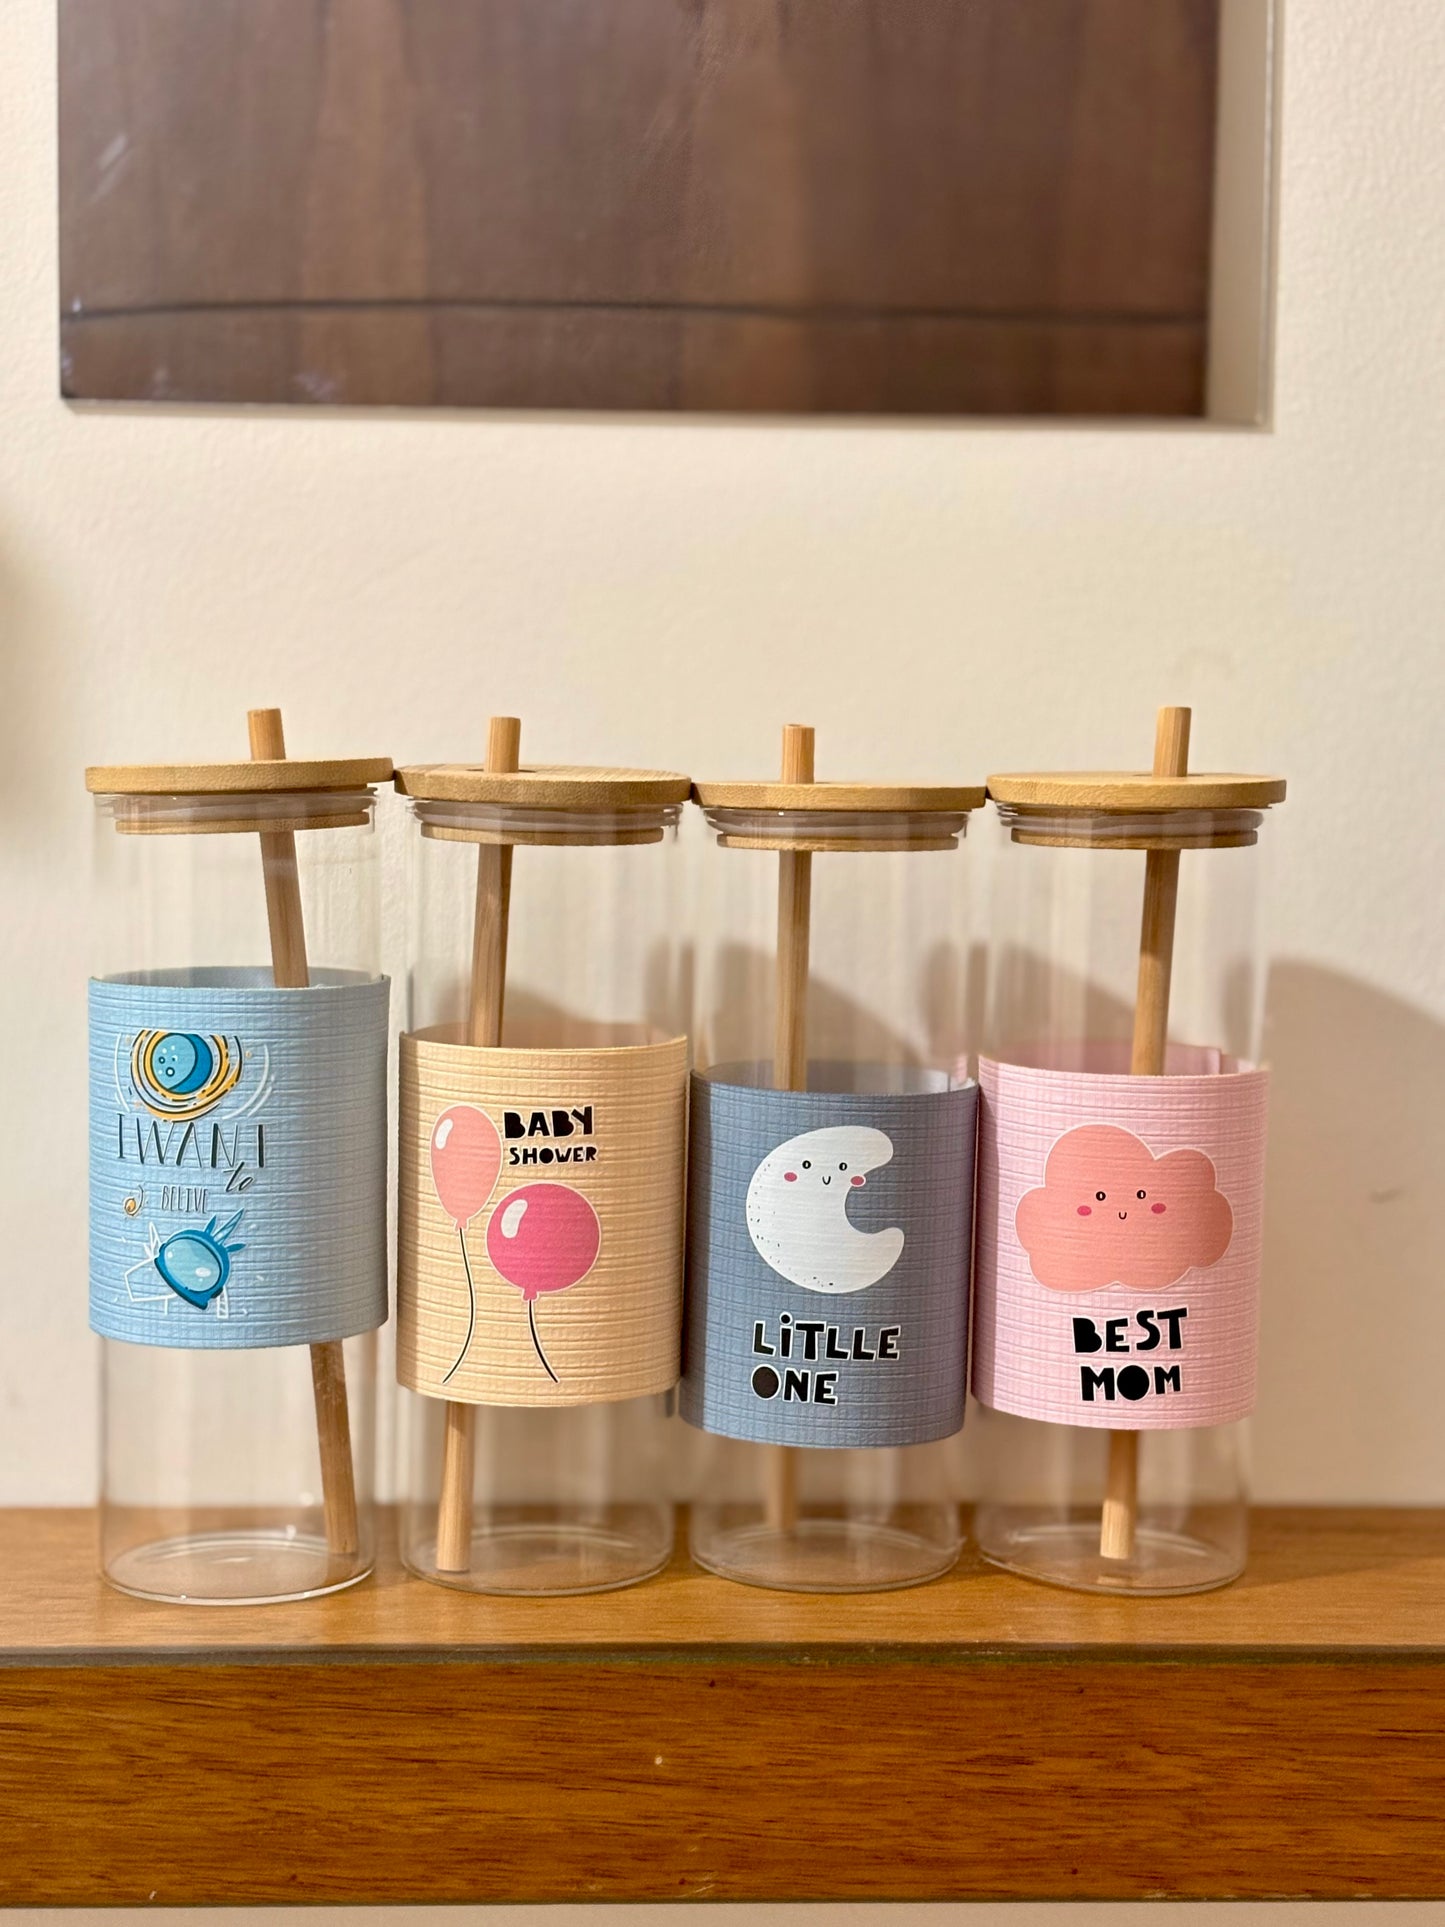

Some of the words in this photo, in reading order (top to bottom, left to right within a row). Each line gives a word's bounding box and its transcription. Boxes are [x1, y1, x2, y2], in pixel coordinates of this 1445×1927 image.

[503, 1106, 593, 1138] BABY
[117, 1113, 125, 1159] I
[136, 1118, 270, 1168] WANT
[509, 1146, 597, 1166] SHOWER
[223, 1161, 254, 1193] to
[1072, 1307, 1188, 1353] BEST
[752, 1365, 838, 1405] ONE
[1080, 1365, 1181, 1401] MOM
